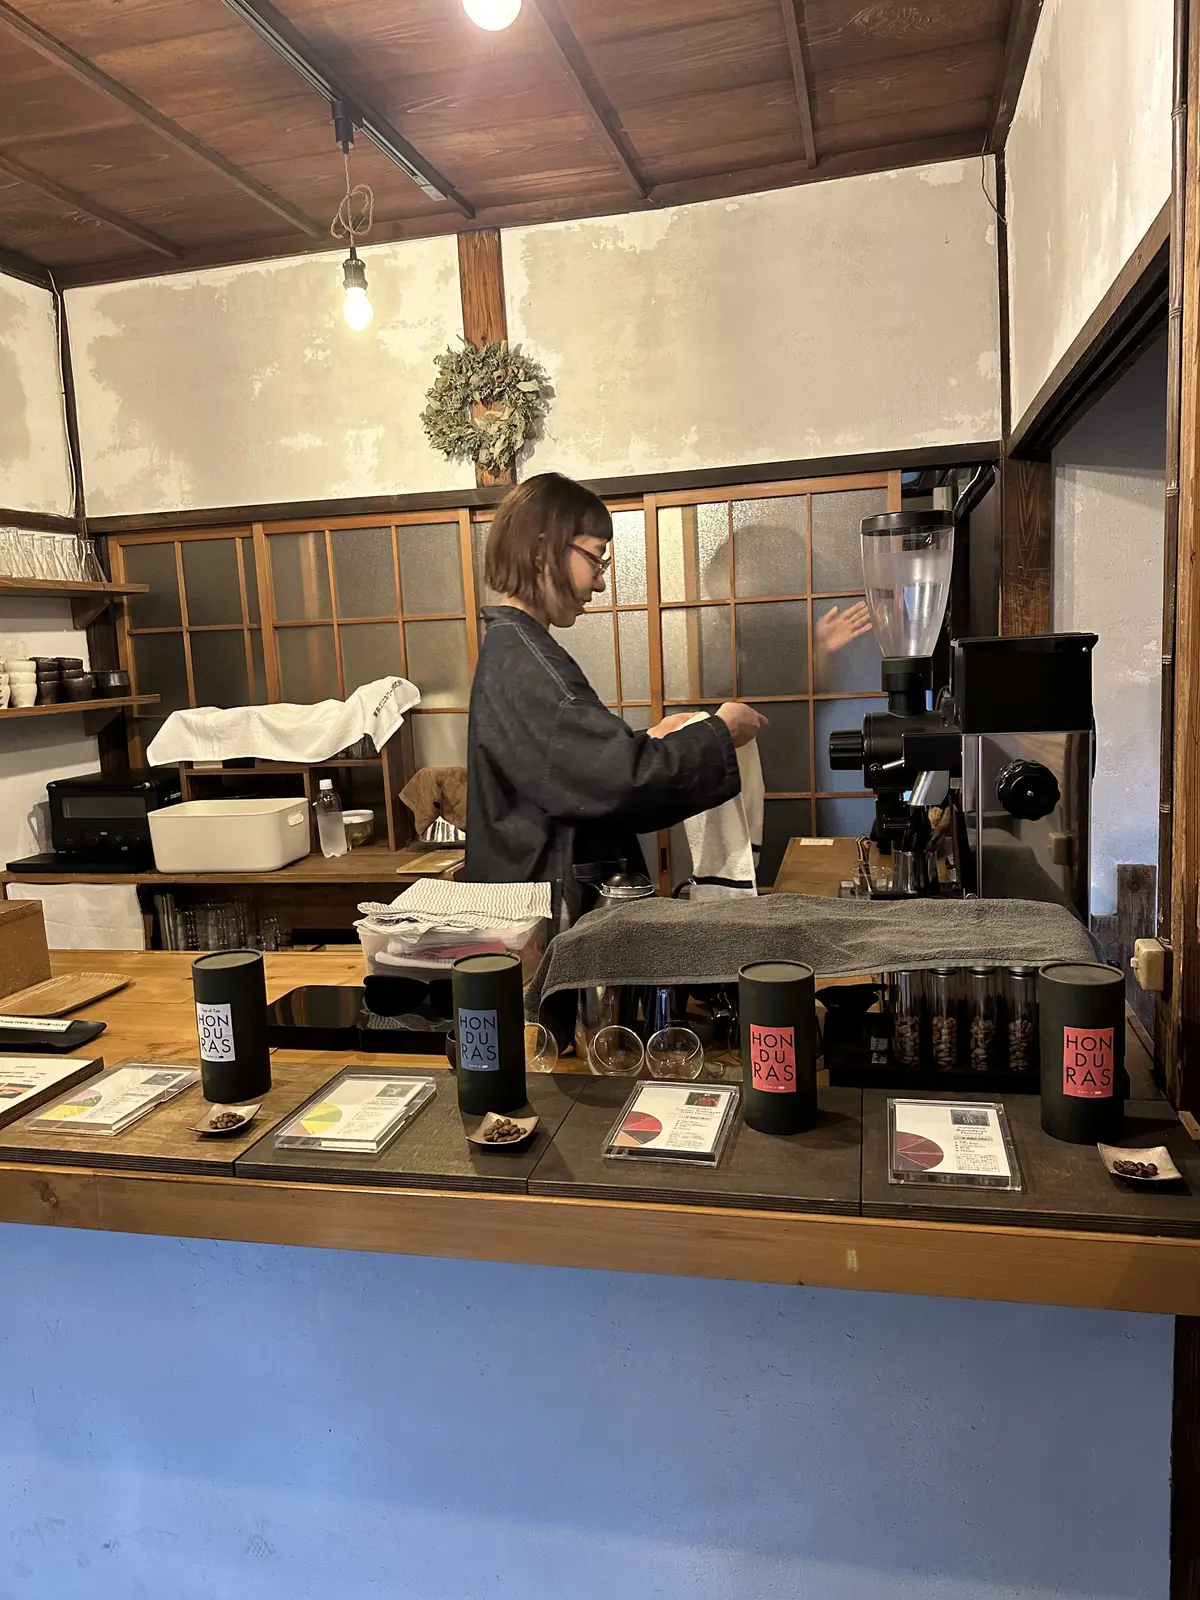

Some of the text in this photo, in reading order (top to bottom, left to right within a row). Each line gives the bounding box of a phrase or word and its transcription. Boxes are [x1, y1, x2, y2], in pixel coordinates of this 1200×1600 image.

[199, 1014, 229, 1027] HON
[460, 1015, 496, 1031] HON
[203, 1027, 223, 1039] DU
[465, 1031, 489, 1045] DU
[752, 1031, 793, 1048] HON
[201, 1037, 231, 1053] RAS
[1066, 1034, 1112, 1051] HON
[461, 1043, 496, 1061] RAS
[759, 1048, 785, 1064] DU
[1075, 1052, 1104, 1068] DU
[753, 1061, 794, 1082] RAS
[1066, 1066, 1111, 1087] RAS
